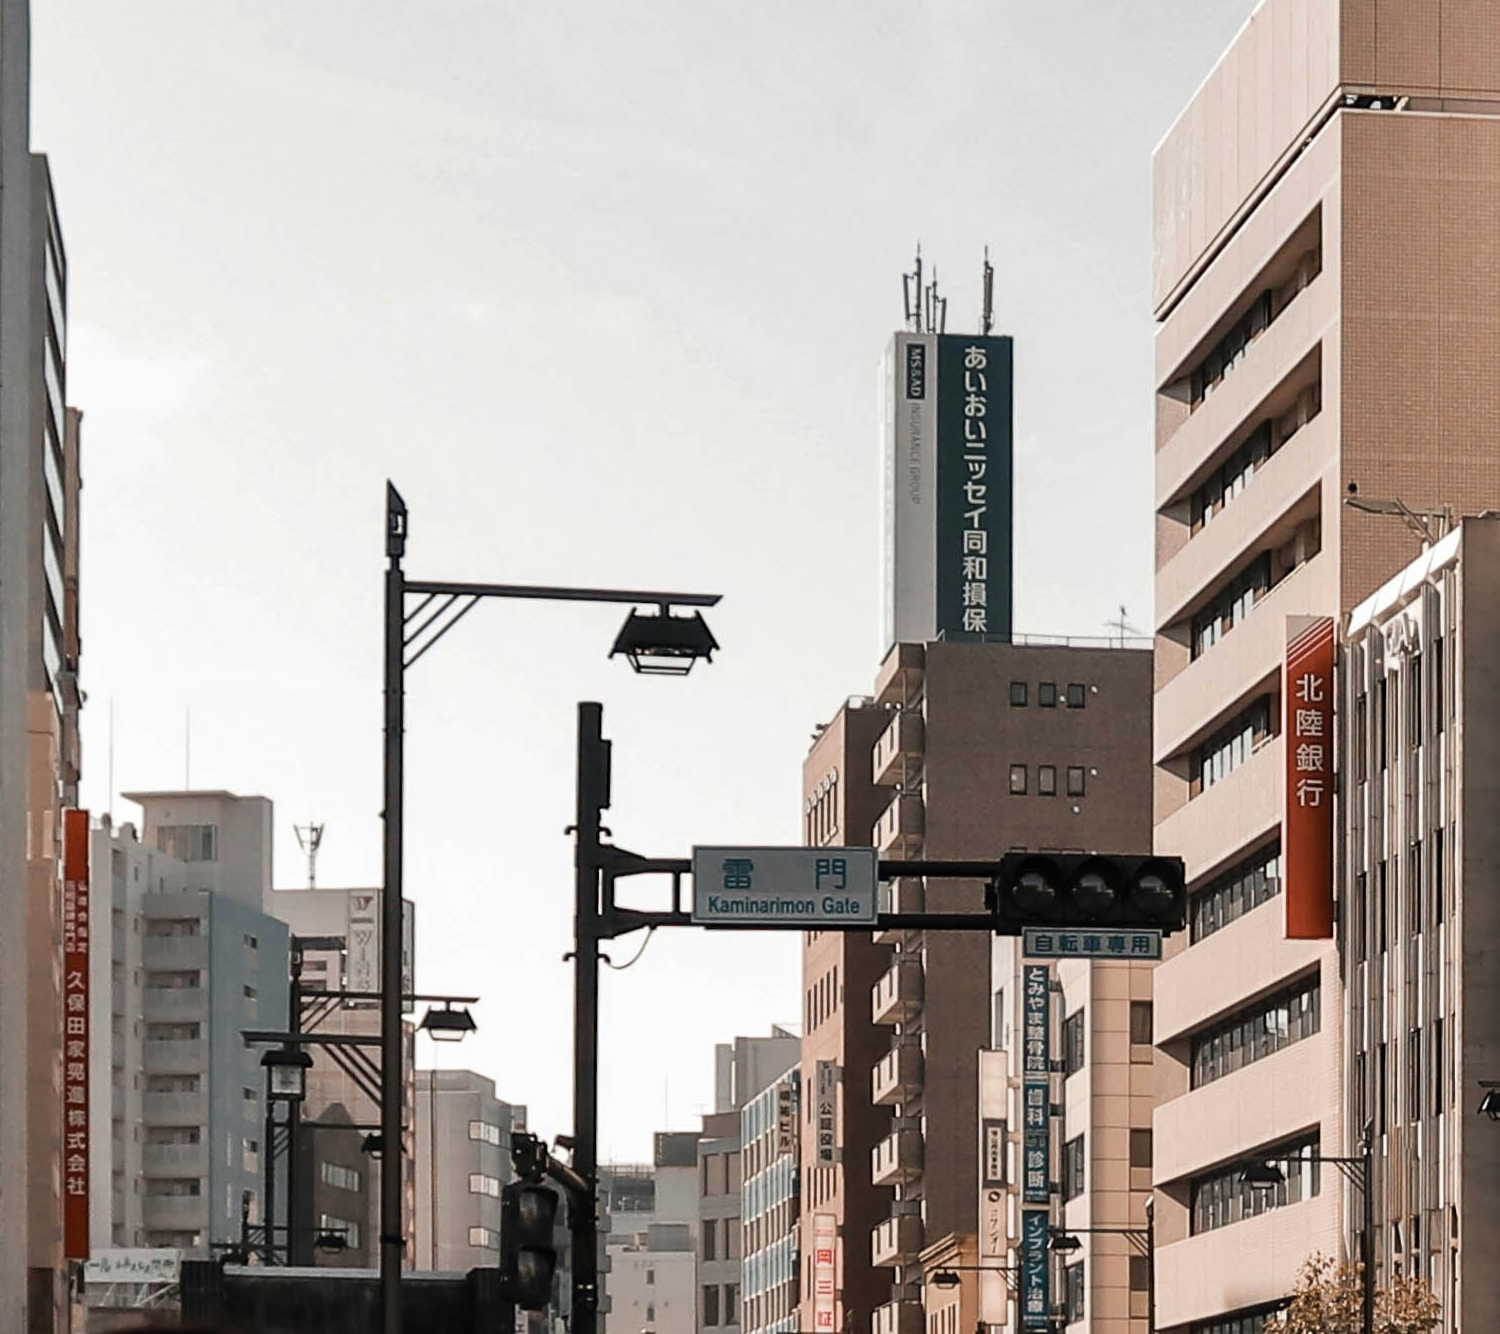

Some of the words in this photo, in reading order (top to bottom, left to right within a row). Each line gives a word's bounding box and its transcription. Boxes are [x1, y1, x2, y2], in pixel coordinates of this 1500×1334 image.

[909, 403, 921, 463] INSURANCE
[909, 465, 921, 505] GROUP
[962, 346, 988, 632] あいおいニッセイ同和損保
[1296, 673, 1324, 807] 北陸銀行
[723, 858, 847, 890] 雷門
[708, 896, 815, 914] Kaminarimon
[822, 897, 860, 914] Gate
[1035, 934, 1151, 953] 自転車専用
[1027, 968, 1045, 1070] とみやま整骨院
